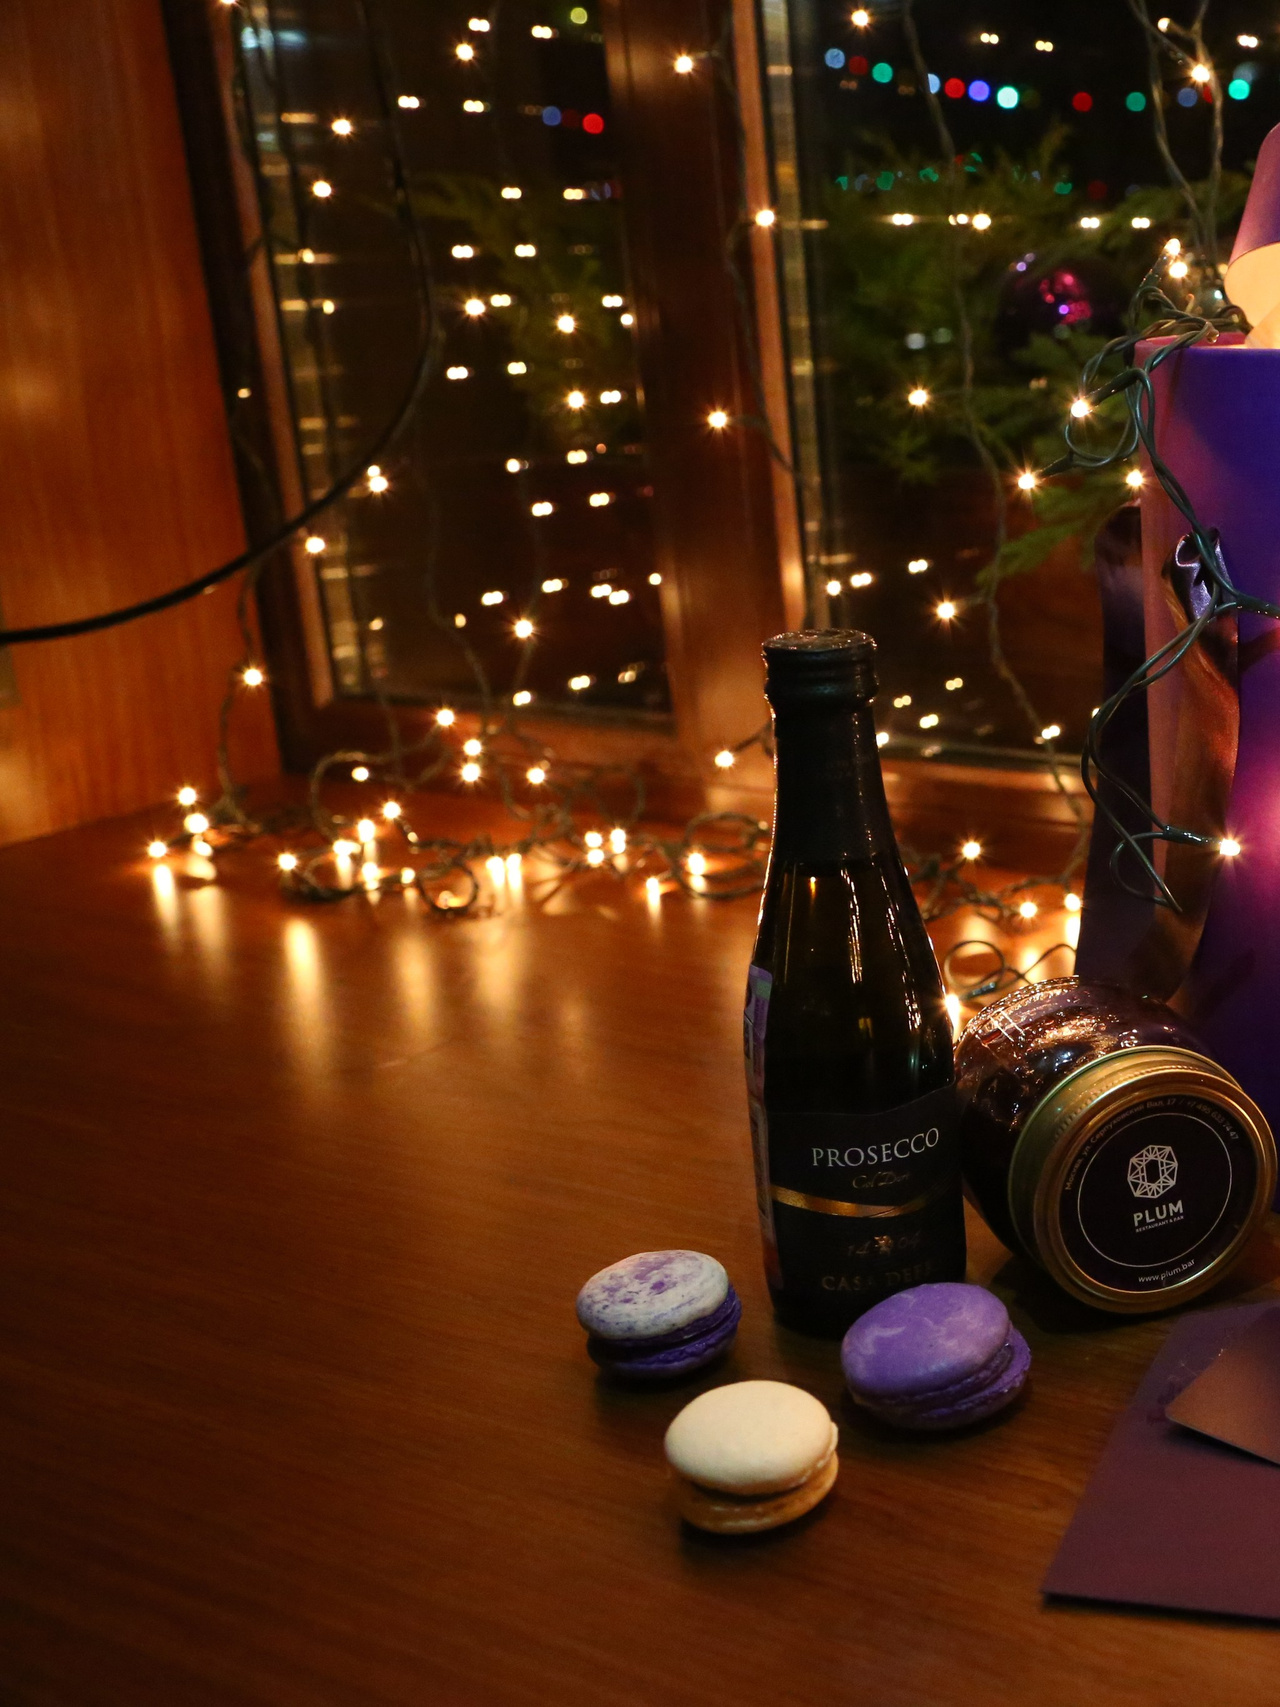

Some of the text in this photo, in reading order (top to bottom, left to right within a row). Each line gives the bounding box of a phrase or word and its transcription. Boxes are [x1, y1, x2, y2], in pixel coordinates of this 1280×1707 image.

[811, 1127, 940, 1167] PROSECCO
[1133, 1199, 1184, 1227] PLUM
[1138, 1258, 1195, 1283] www.plum.bar
